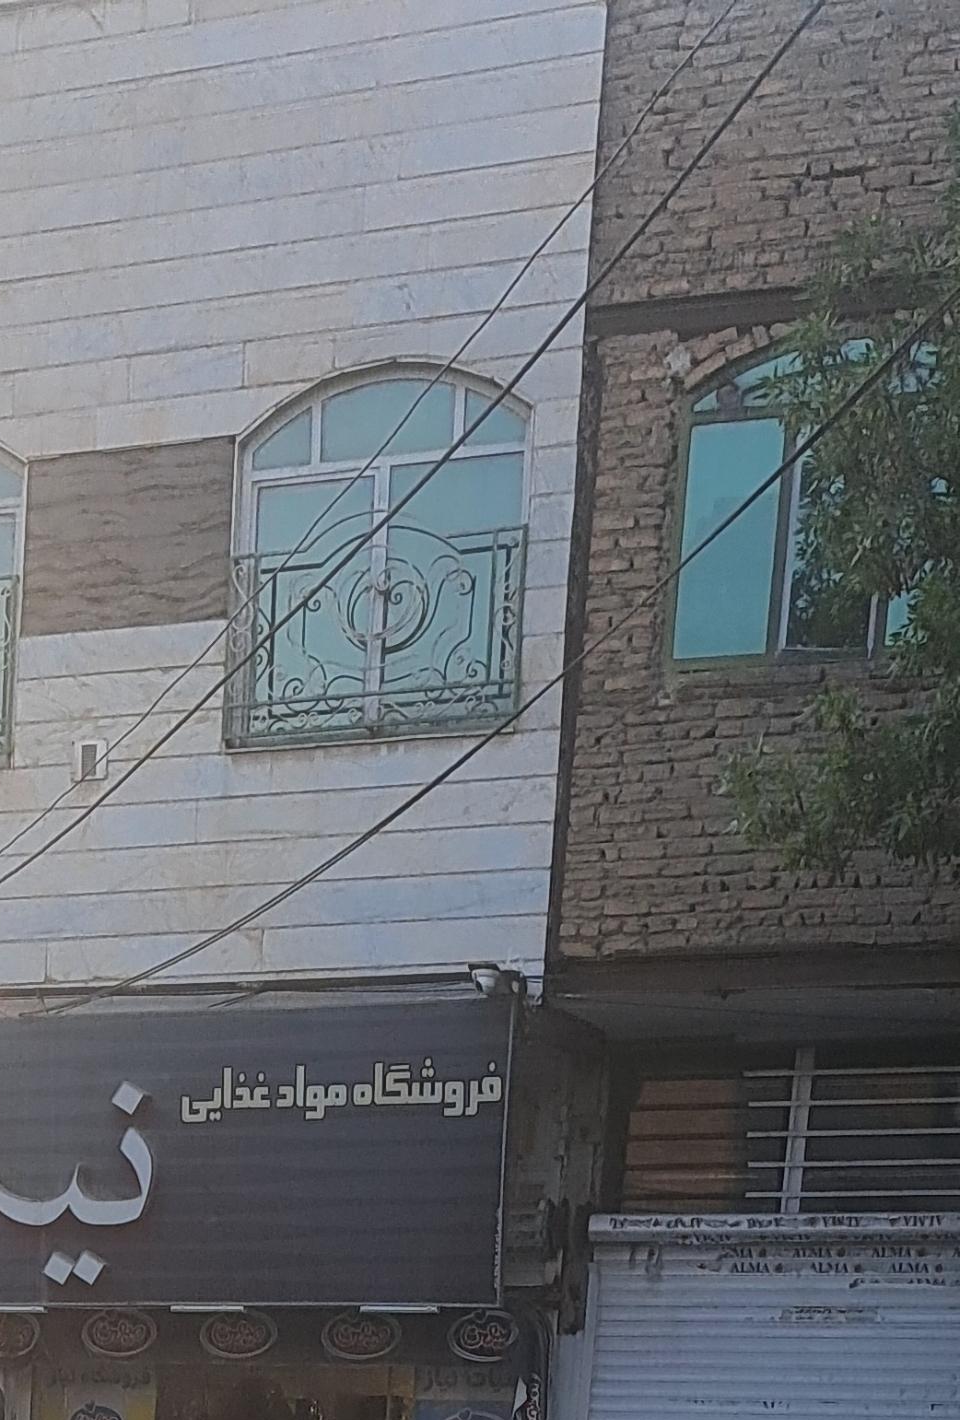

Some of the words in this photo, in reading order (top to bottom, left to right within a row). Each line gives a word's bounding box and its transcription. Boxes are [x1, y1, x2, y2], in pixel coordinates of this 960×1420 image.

[181, 1067, 271, 1123] غذایی
[276, 1064, 347, 1119] مواد
[353, 1058, 503, 1117] فروشگاه
